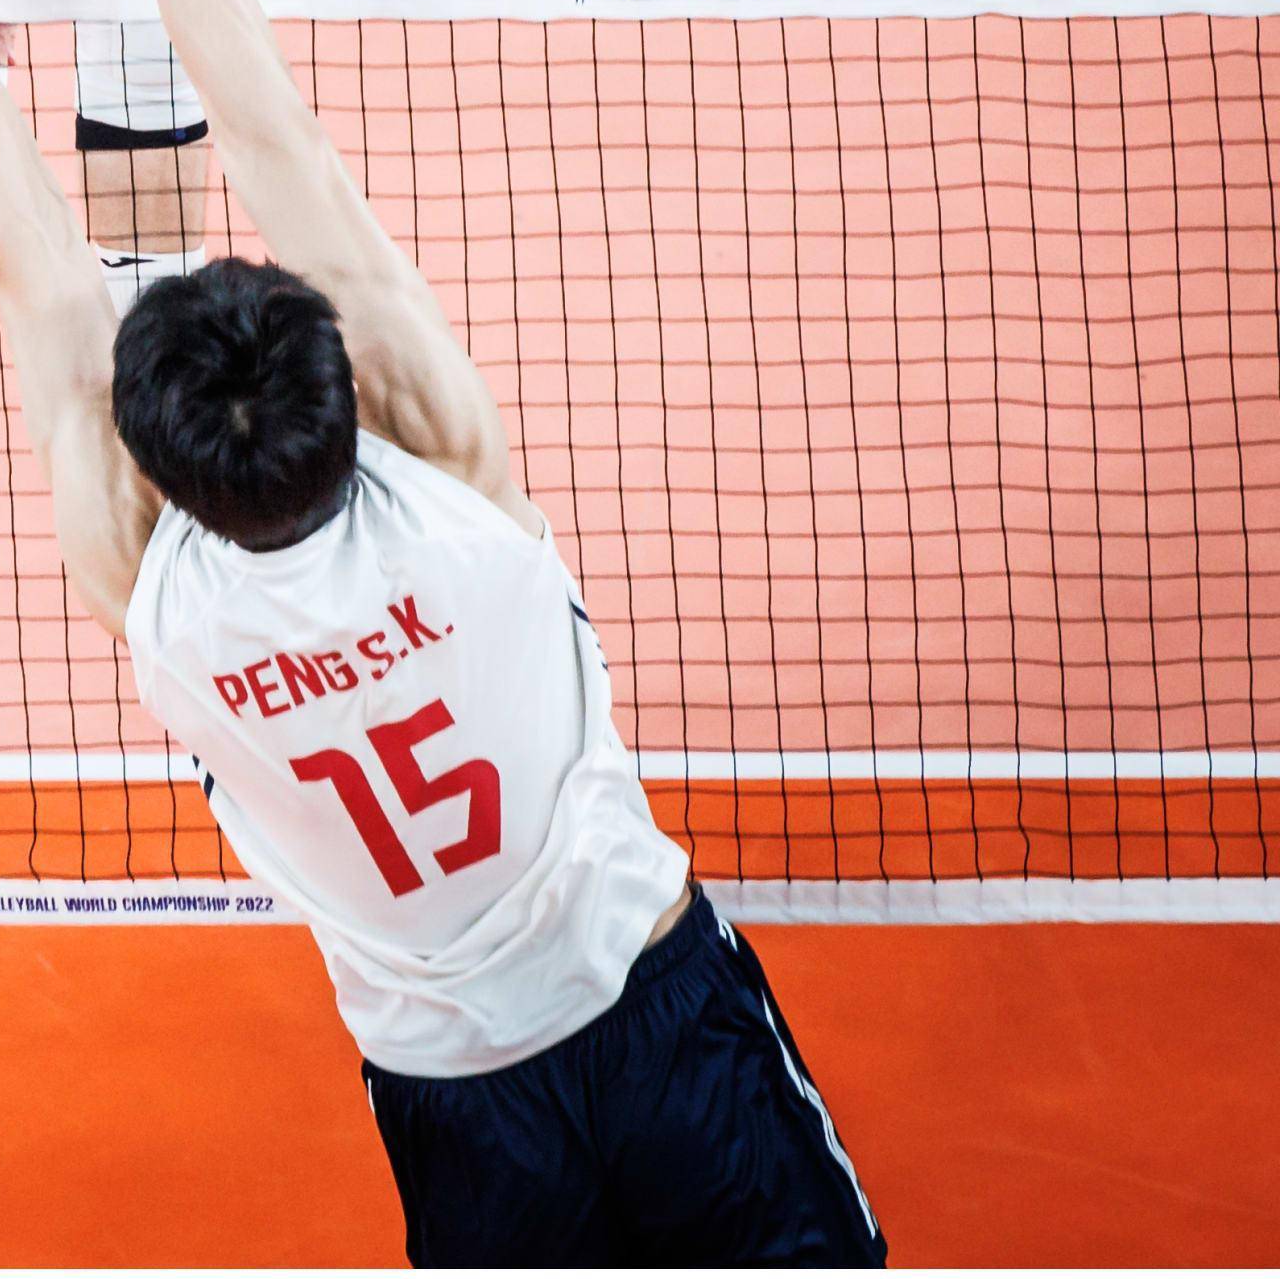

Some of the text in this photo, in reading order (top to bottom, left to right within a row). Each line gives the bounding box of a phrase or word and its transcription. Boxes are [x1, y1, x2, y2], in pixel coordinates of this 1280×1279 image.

[212, 651, 360, 719] PENG
[288, 697, 501, 899] 15
[64, 896, 118, 913] WORLD
[122, 895, 231, 913] CHAMPIONSHIP
[236, 896, 275, 913] 2022
